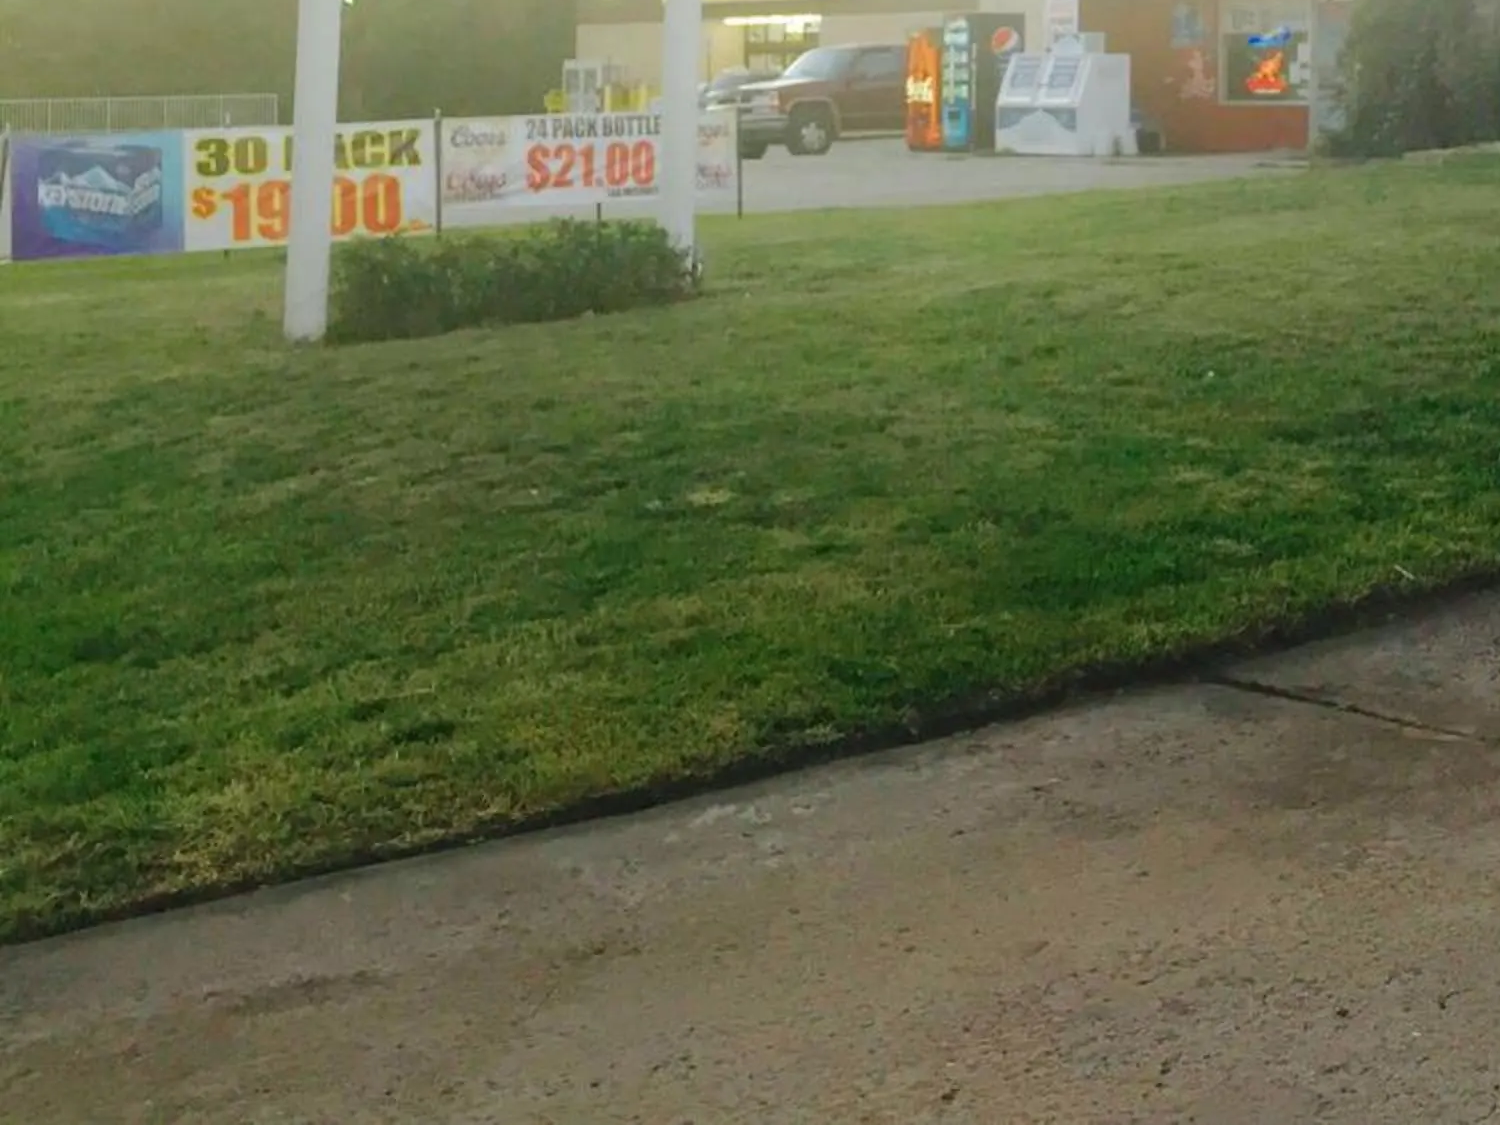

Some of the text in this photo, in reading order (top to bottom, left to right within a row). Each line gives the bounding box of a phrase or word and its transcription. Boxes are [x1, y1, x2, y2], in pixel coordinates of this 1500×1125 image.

[525, 113, 661, 140] 24 PACK BOTTLE
[195, 128, 422, 177] 30 CK
[526, 140, 656, 193] $21.00
[191, 172, 403, 242] $1900
